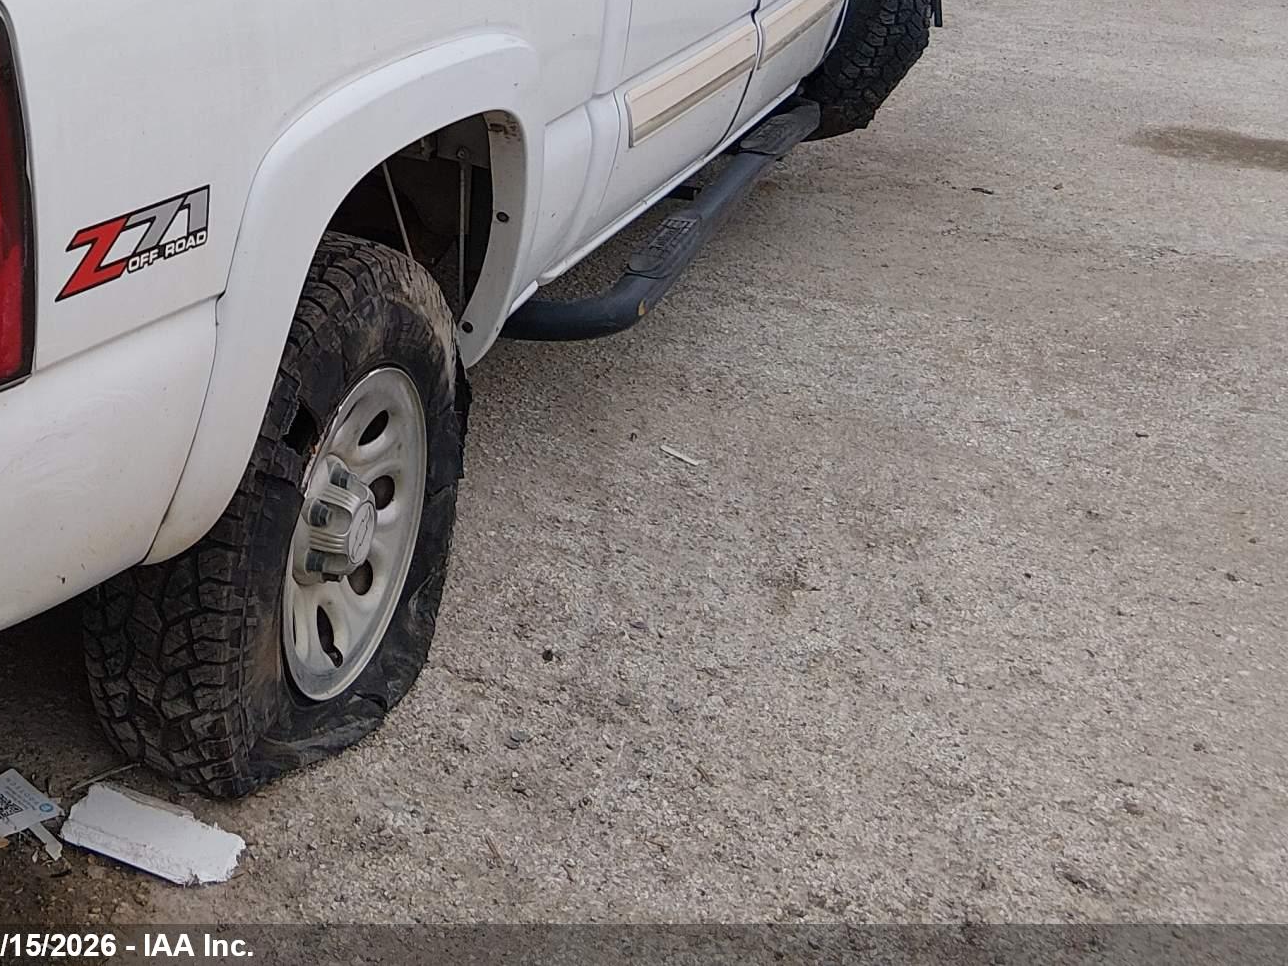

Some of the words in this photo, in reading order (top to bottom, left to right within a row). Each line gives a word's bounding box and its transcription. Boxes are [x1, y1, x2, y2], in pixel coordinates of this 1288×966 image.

[55, 184, 210, 302] Z71
[127, 248, 159, 273] OFF
[163, 231, 208, 259] ROAD
